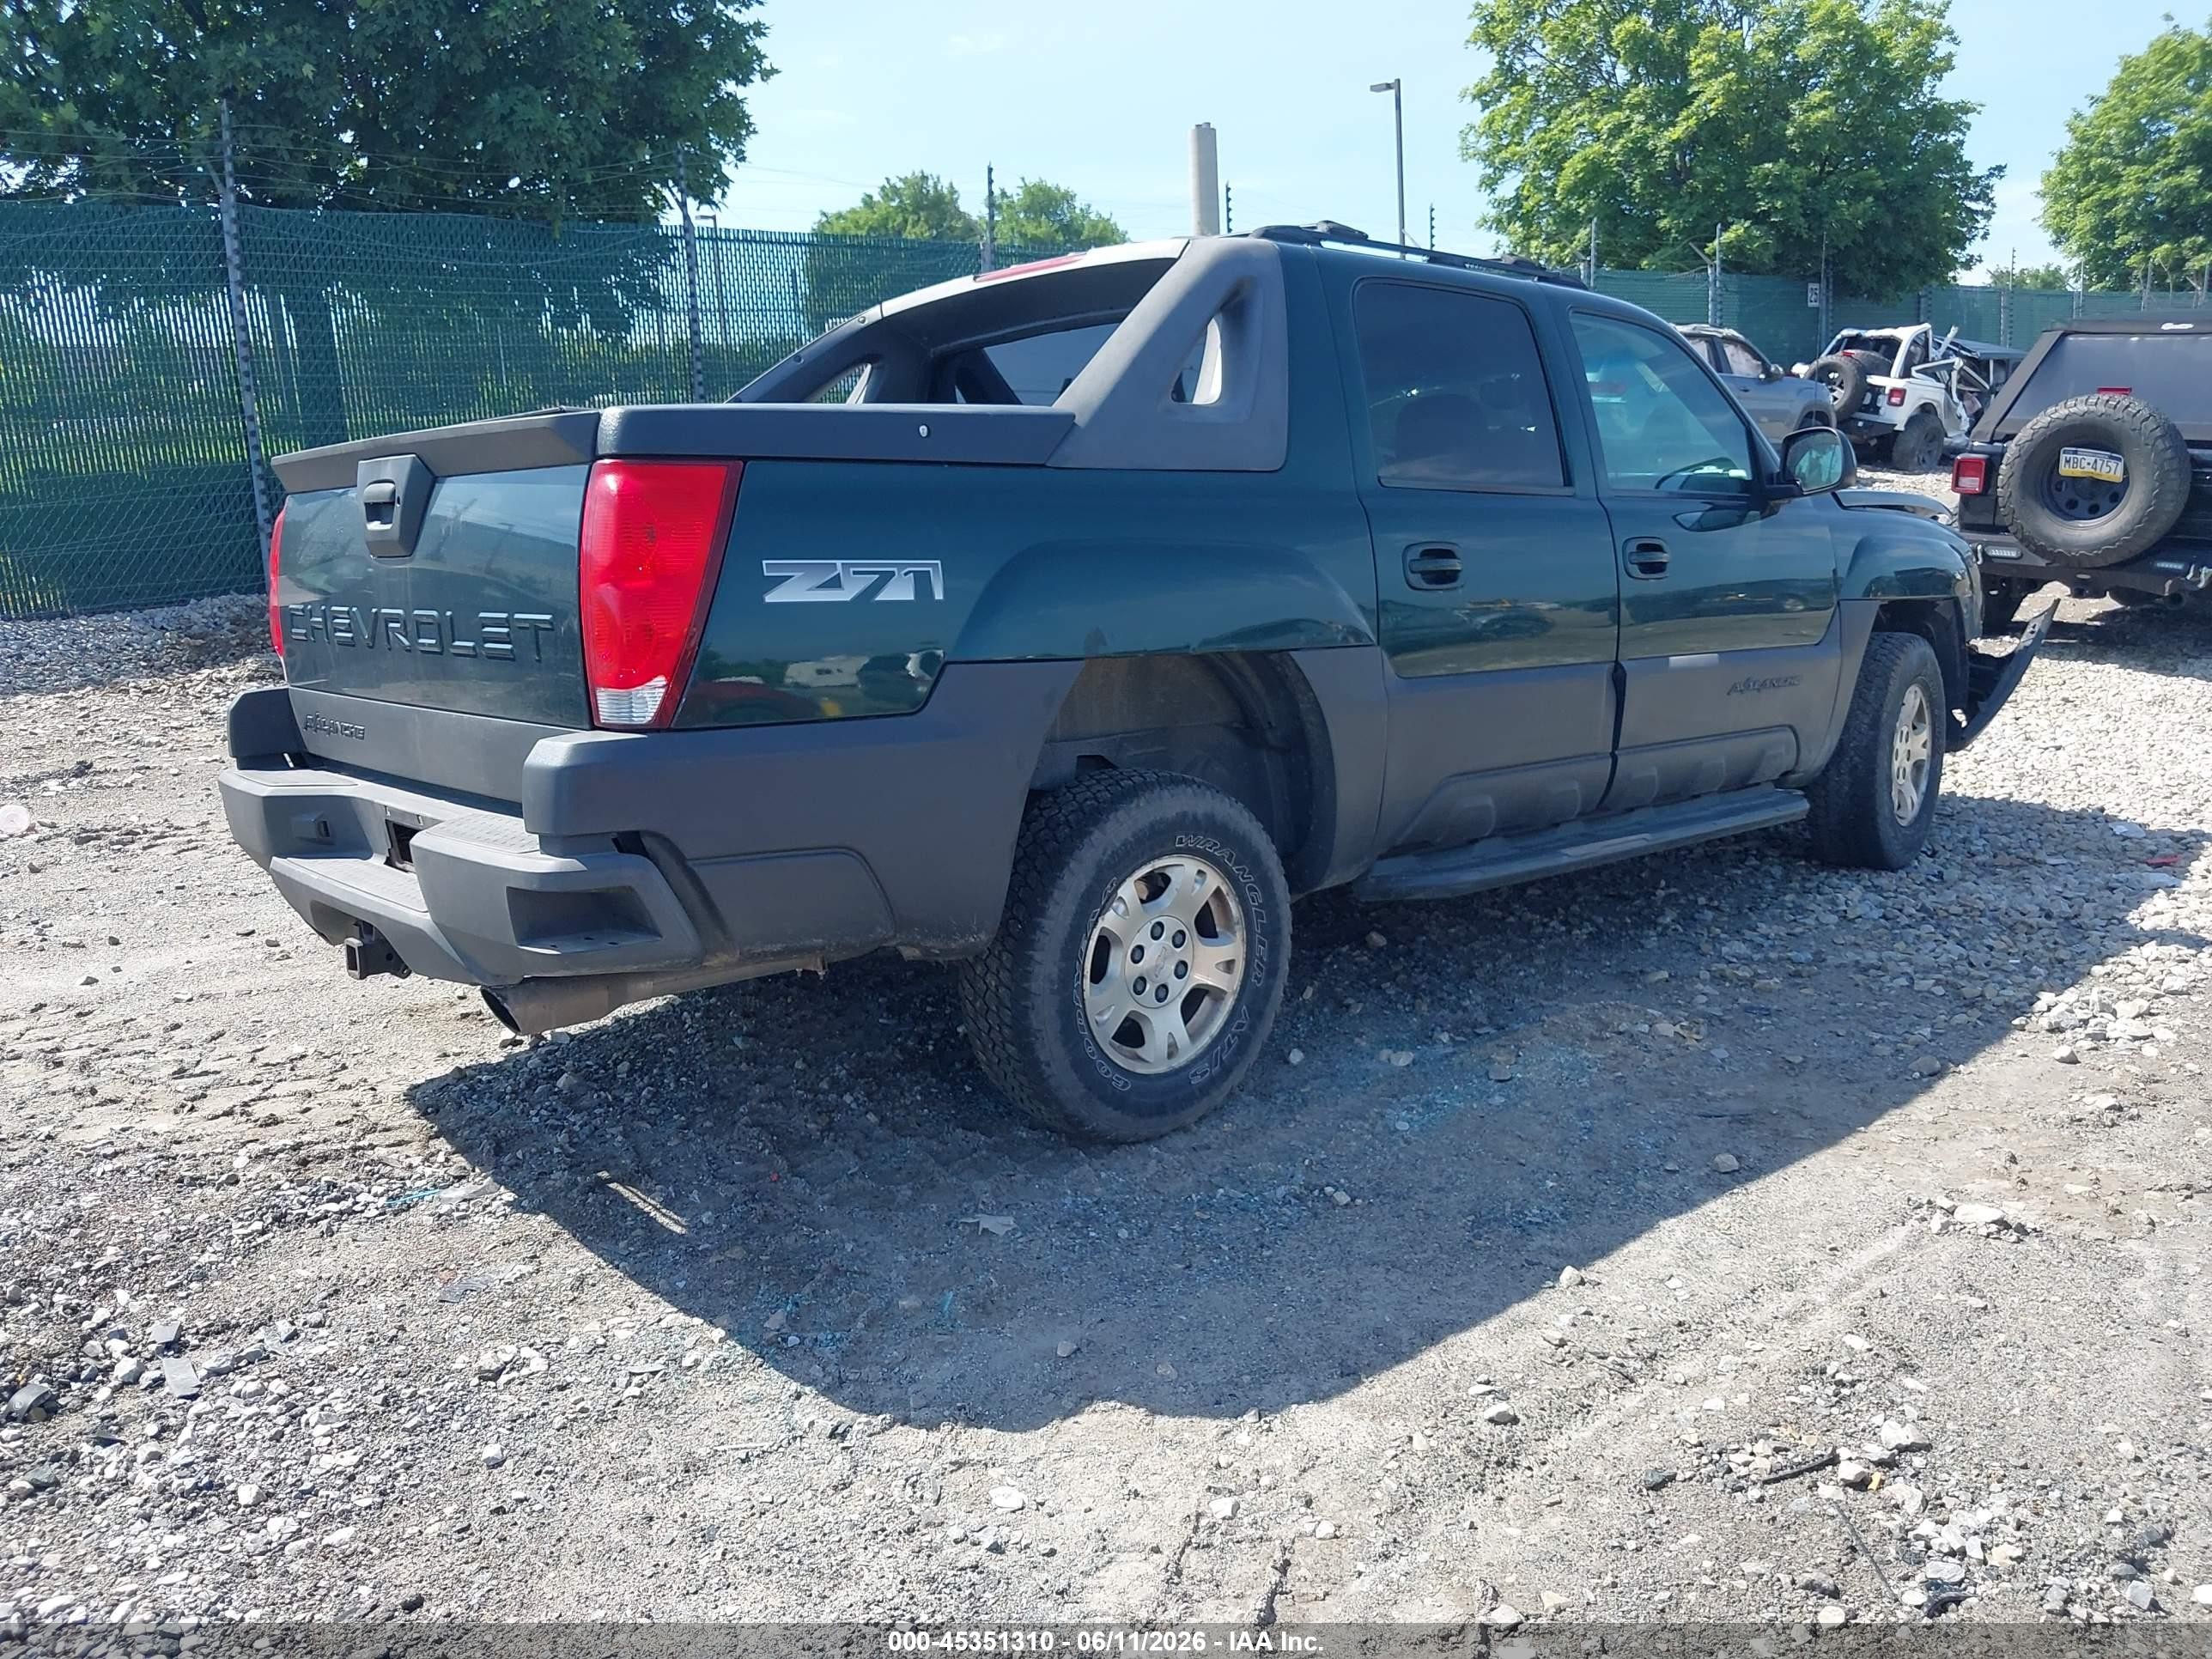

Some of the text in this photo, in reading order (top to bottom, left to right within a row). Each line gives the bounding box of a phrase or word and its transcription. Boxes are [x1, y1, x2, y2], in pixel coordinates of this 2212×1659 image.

[1808, 287, 1819, 303] 25
[763, 560, 945, 604] Z71
[288, 604, 555, 662] CHEVROLET
[1174, 833, 1270, 1086] WRANGLER AT/S
